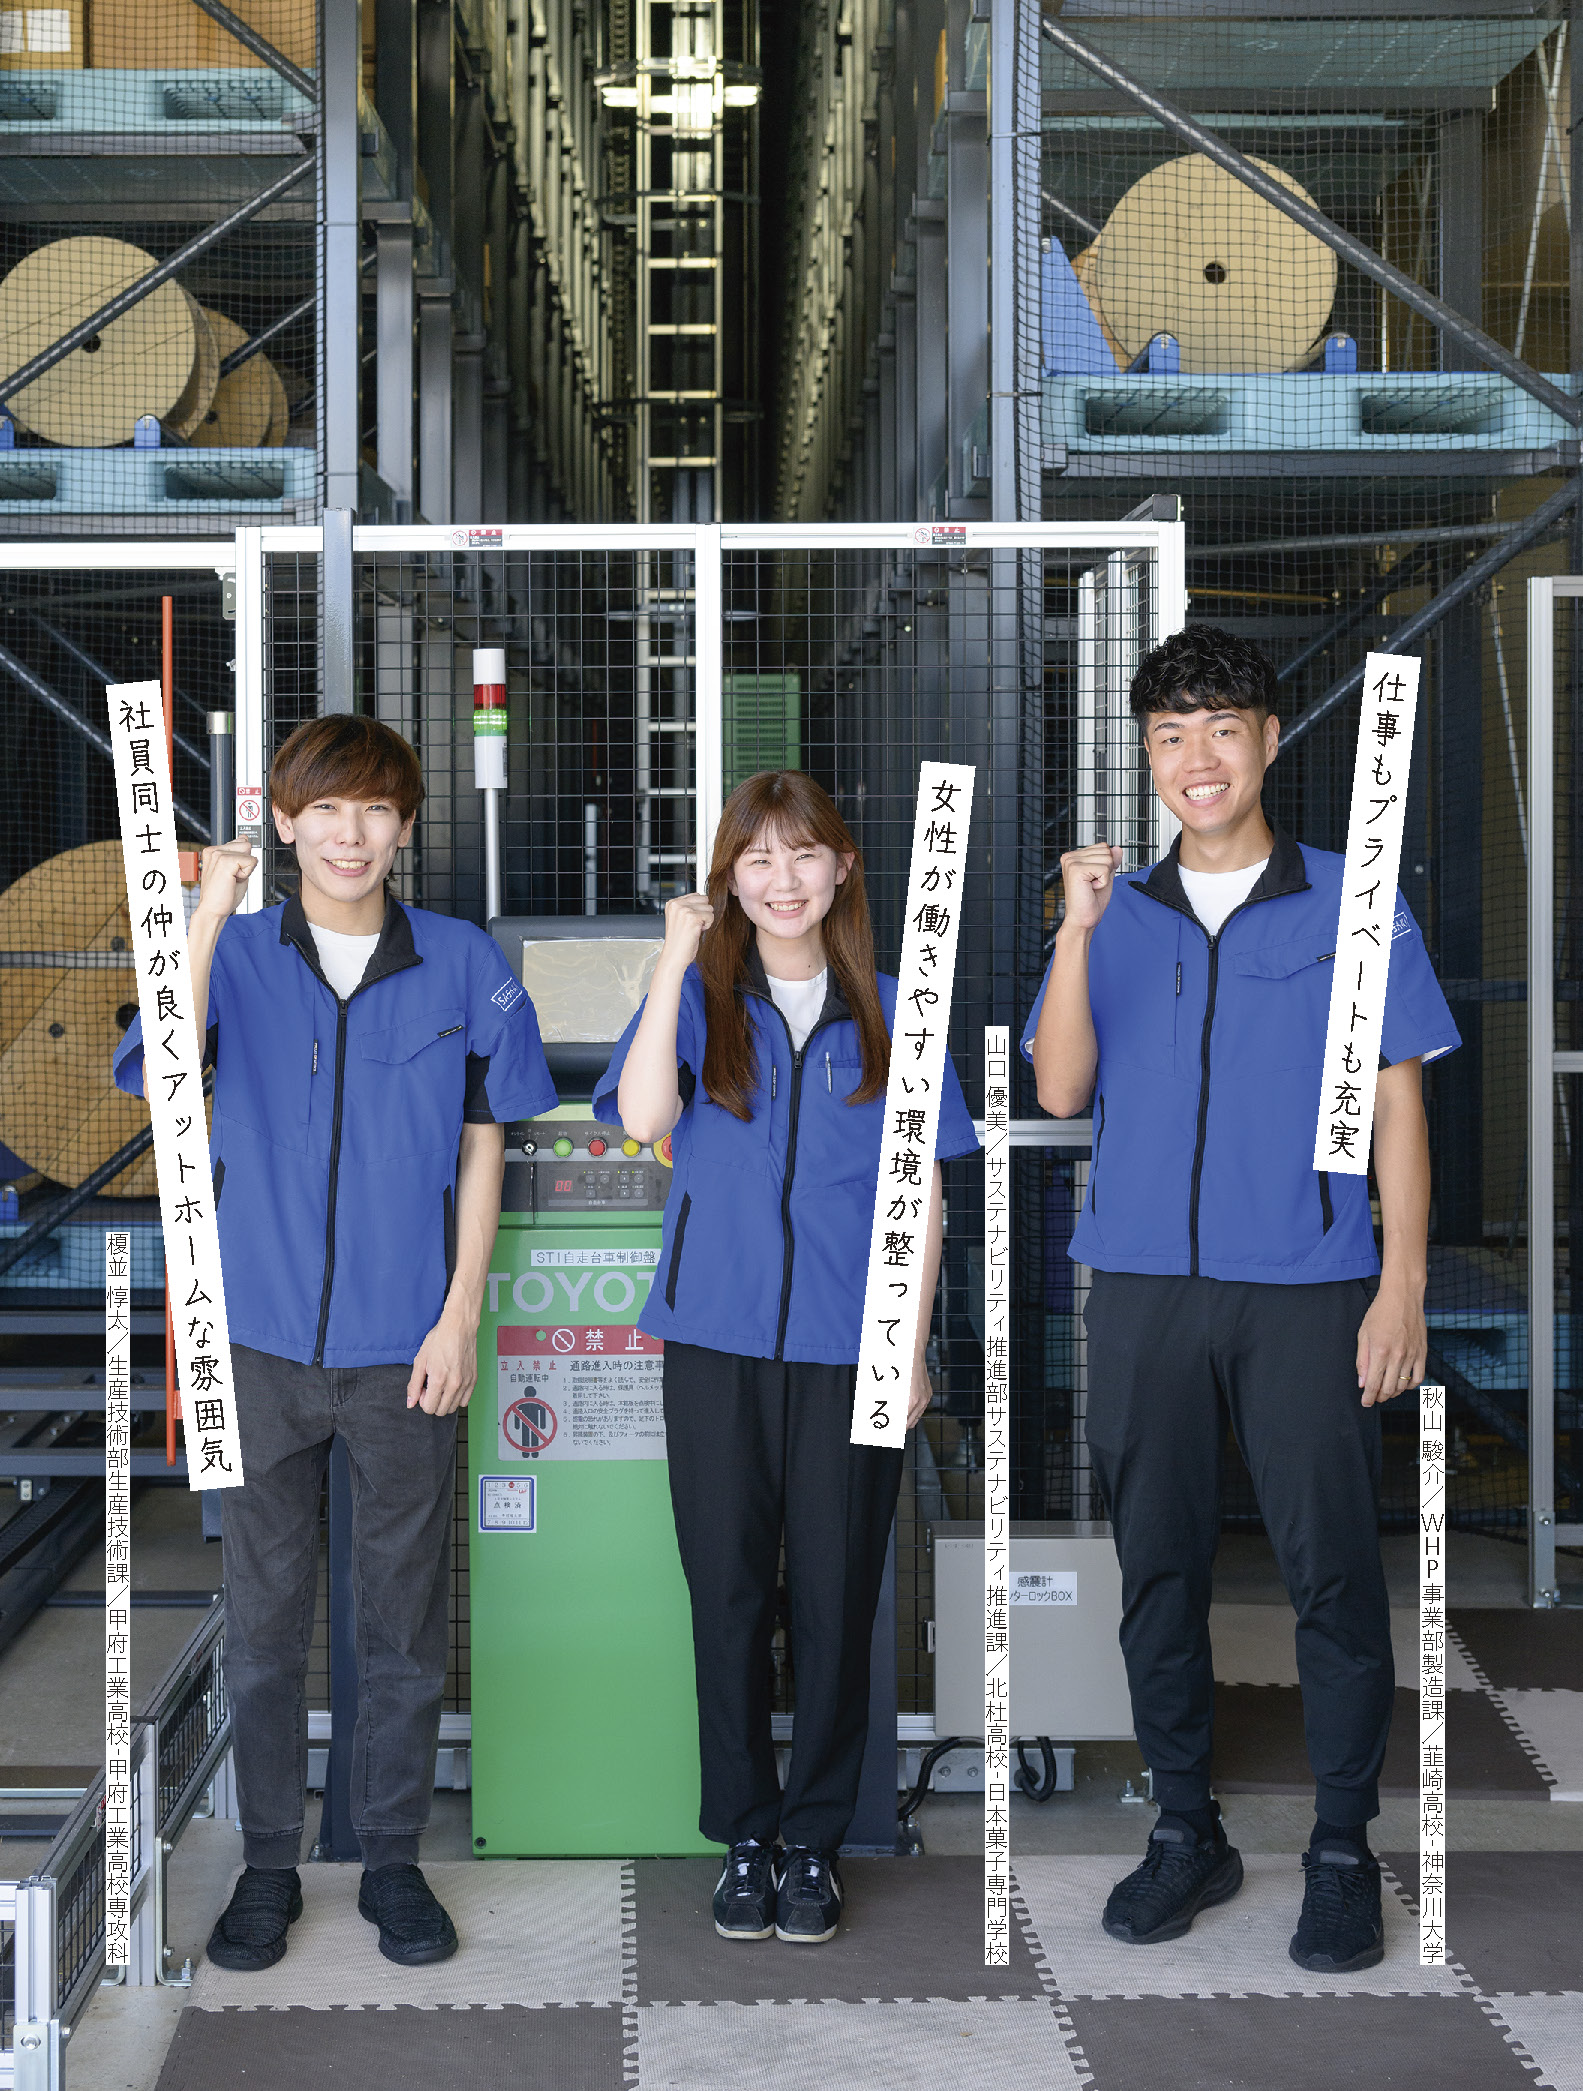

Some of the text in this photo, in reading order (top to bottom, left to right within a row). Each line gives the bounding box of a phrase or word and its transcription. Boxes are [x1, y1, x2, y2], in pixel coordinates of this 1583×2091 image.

[585, 1328, 644, 1351] 禁止
[501, 1360, 556, 1371] 立入禁止
[510, 1374, 549, 1383] 自動運転中
[1009, 1590, 1073, 1602] ターロックBOX
